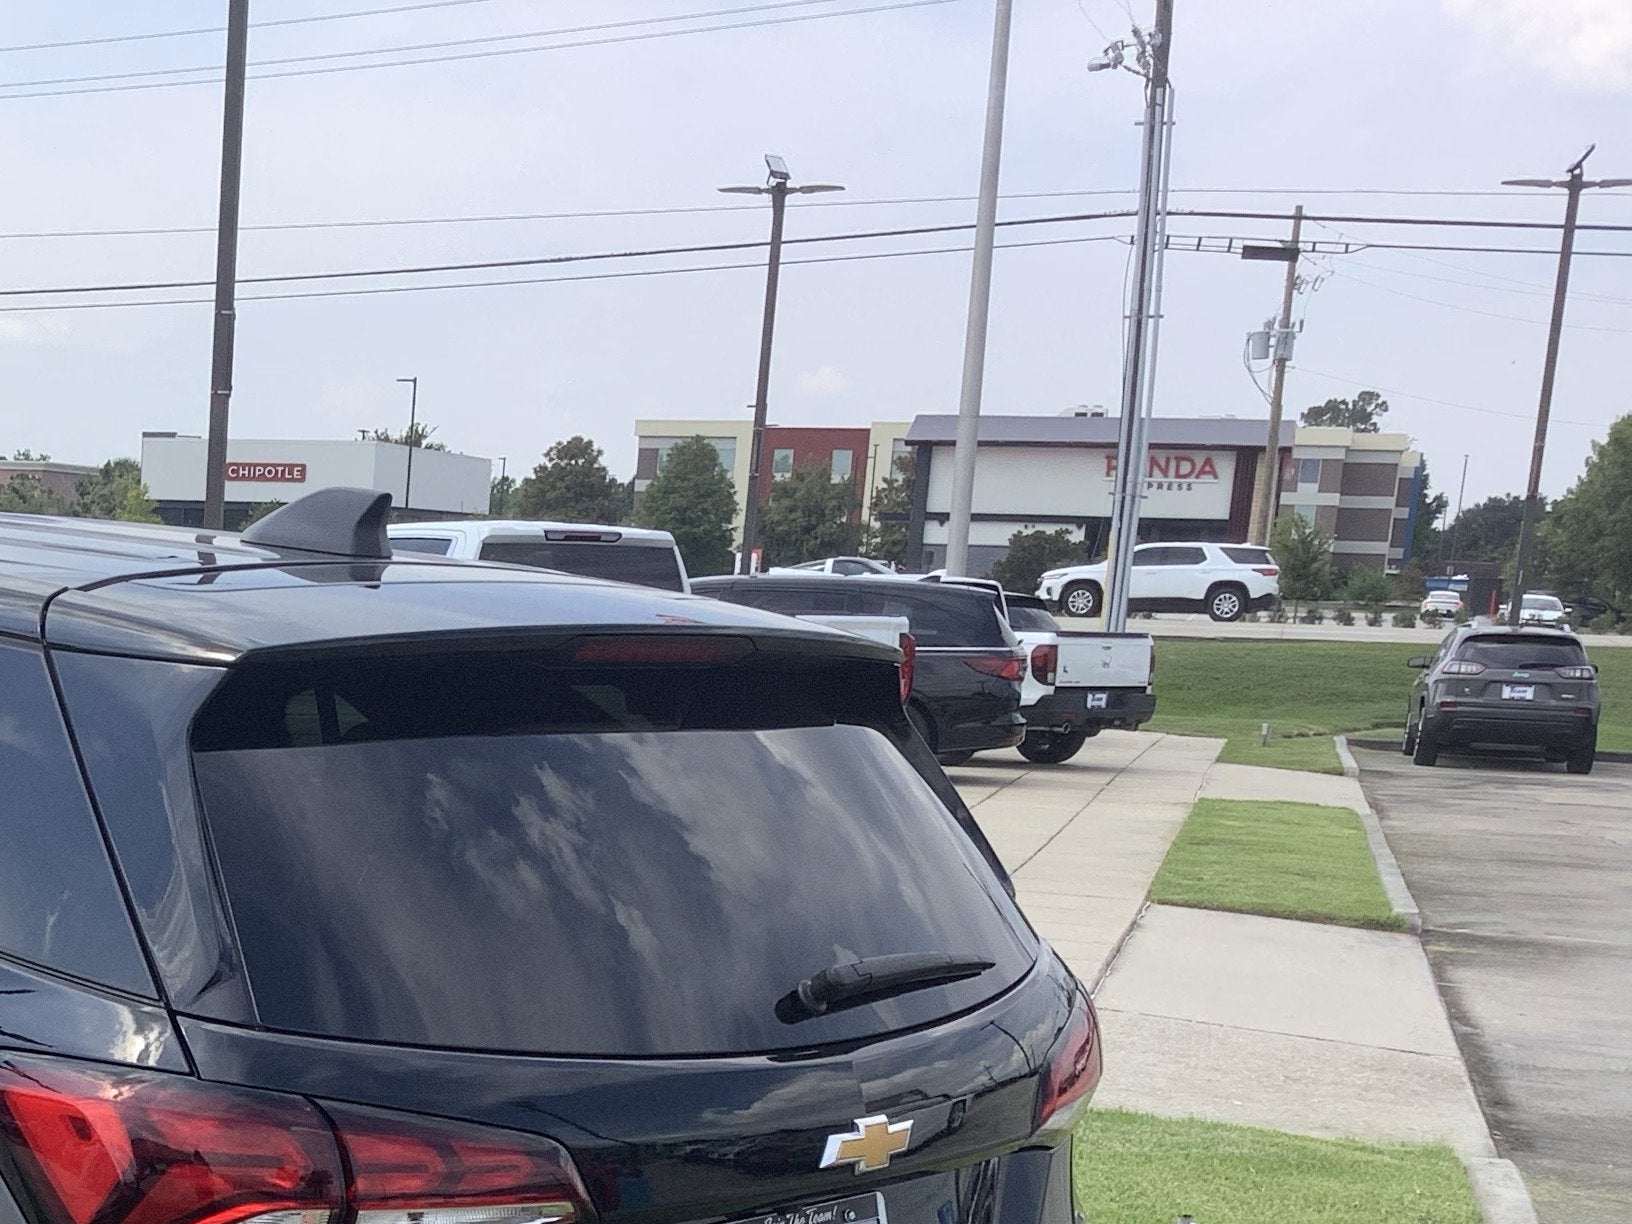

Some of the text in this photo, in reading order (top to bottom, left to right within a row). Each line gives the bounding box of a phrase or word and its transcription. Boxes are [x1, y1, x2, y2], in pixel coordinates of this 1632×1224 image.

[228, 466, 303, 479] CHIPOTLE
[1105, 455, 1218, 480] PNDA
[1146, 482, 1193, 491] PRESS
